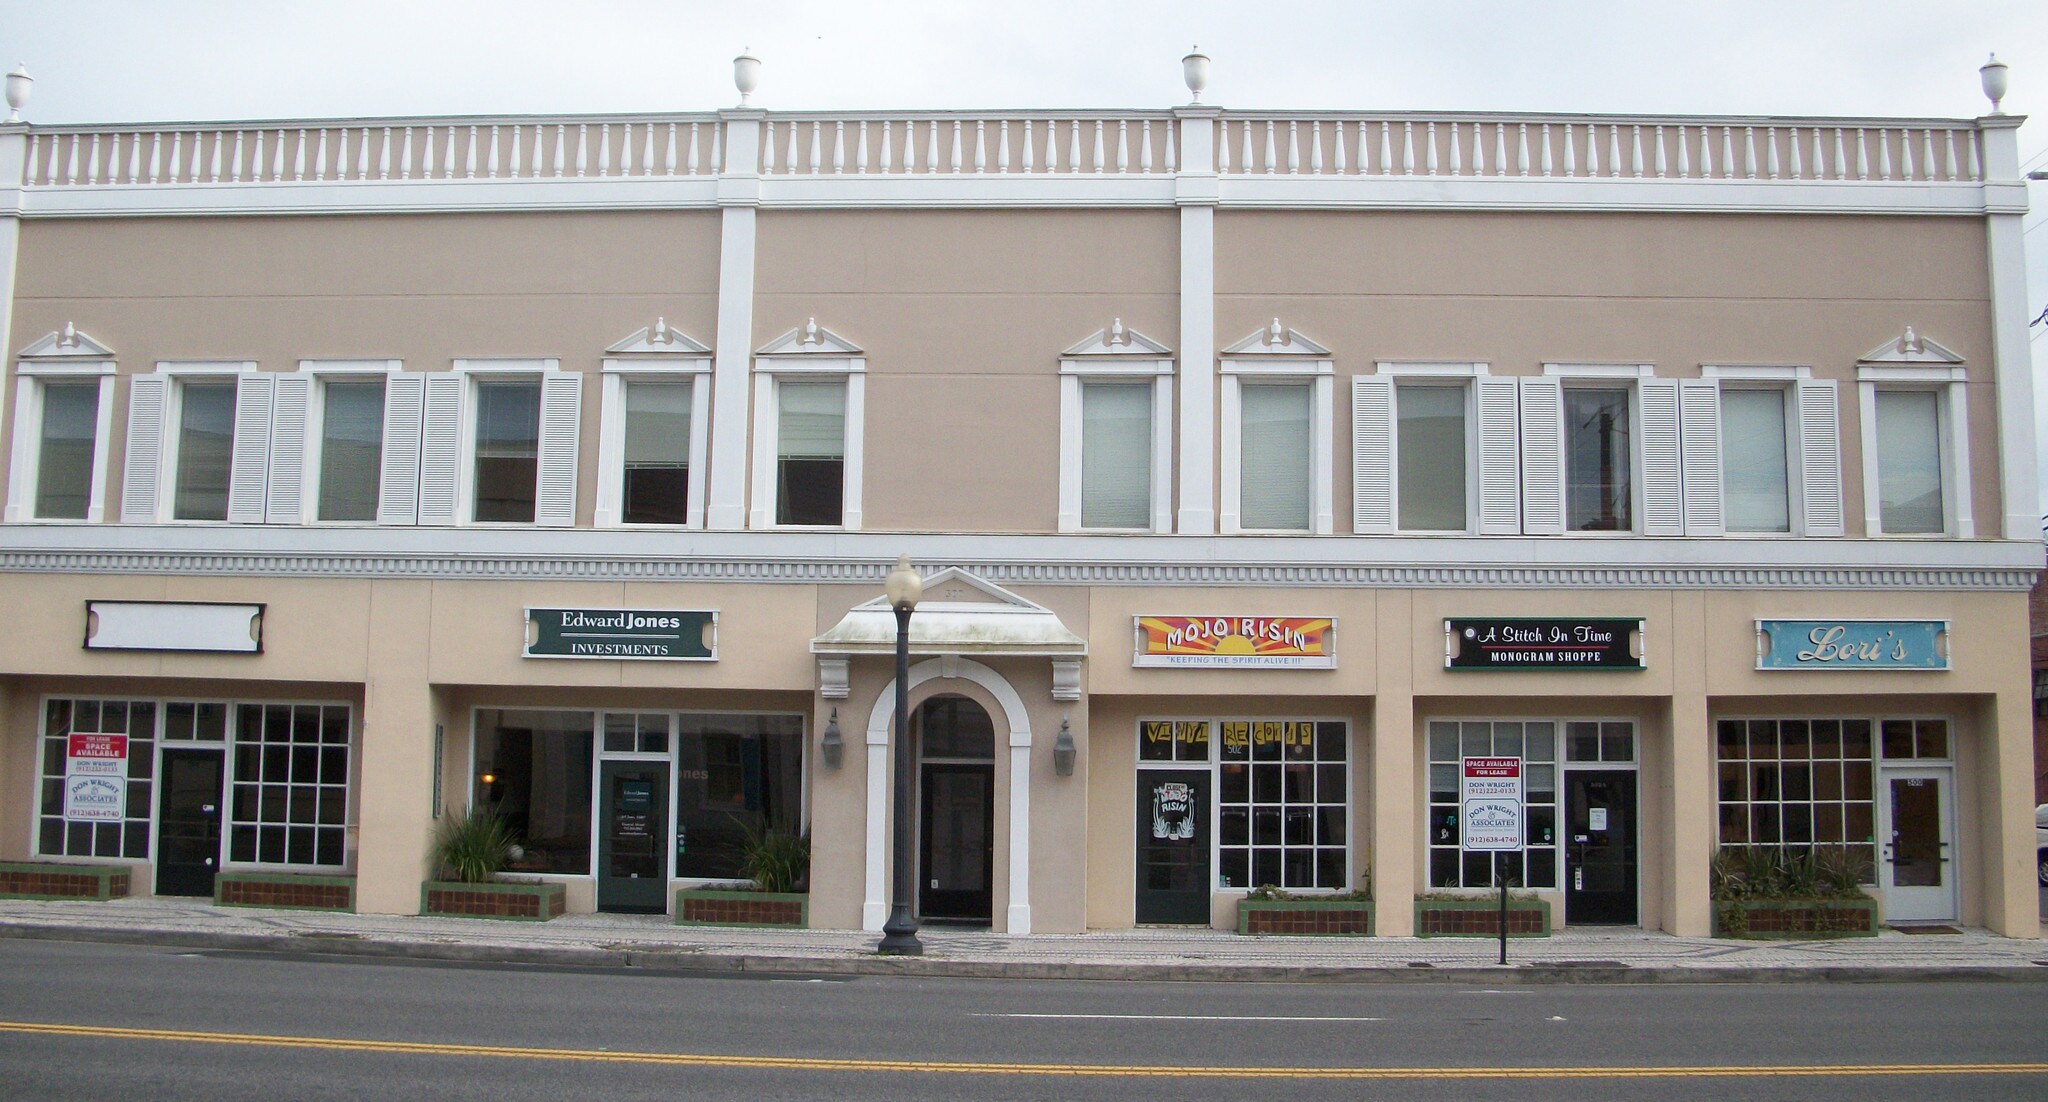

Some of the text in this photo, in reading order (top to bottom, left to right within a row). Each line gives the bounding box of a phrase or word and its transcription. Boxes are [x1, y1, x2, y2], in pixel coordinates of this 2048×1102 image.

[1167, 619, 1305, 651] MOJO RISIN
[1477, 626, 1613, 644] A Stitch In Time
[572, 644, 669, 655] INVESTMENTS
[1797, 625, 1908, 661] Lori's
[1232, 656, 1261, 664] SPIRIT
[1264, 657, 1289, 665] ALIVE
[1491, 652, 1601, 662] MONOGRAM SHOPPE
[1149, 723, 1209, 741] VINYL
[1227, 745, 1242, 754] 502
[72, 779, 120, 795] DON WRIGHT
[73, 795, 118, 803] ASSOCIATES
[1161, 801, 1187, 813] RISIN
[1468, 804, 1517, 819] DON WRIGHT
